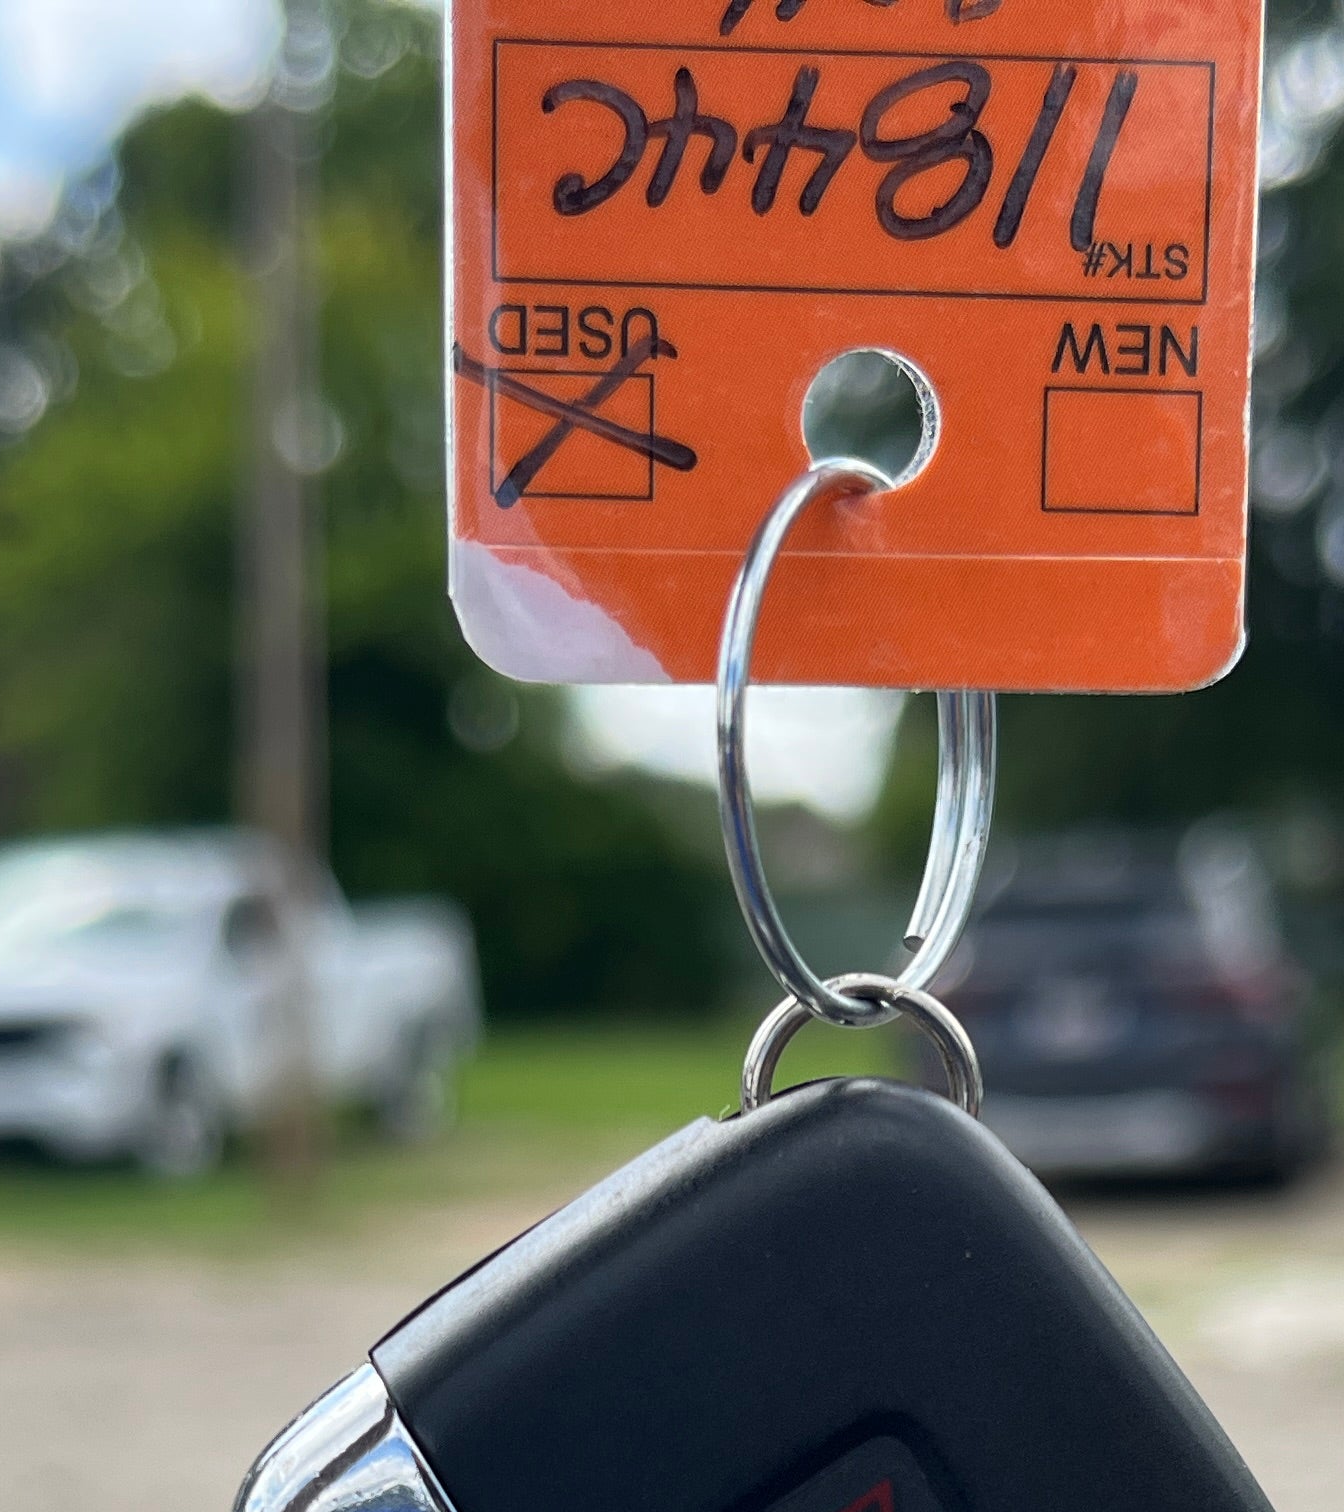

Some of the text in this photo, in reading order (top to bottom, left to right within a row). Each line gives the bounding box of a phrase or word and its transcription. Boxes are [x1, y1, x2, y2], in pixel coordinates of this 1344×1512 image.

[1081, 241, 1190, 281] STK#
[487, 303, 659, 361] USED
[1050, 322, 1199, 378] NEW
